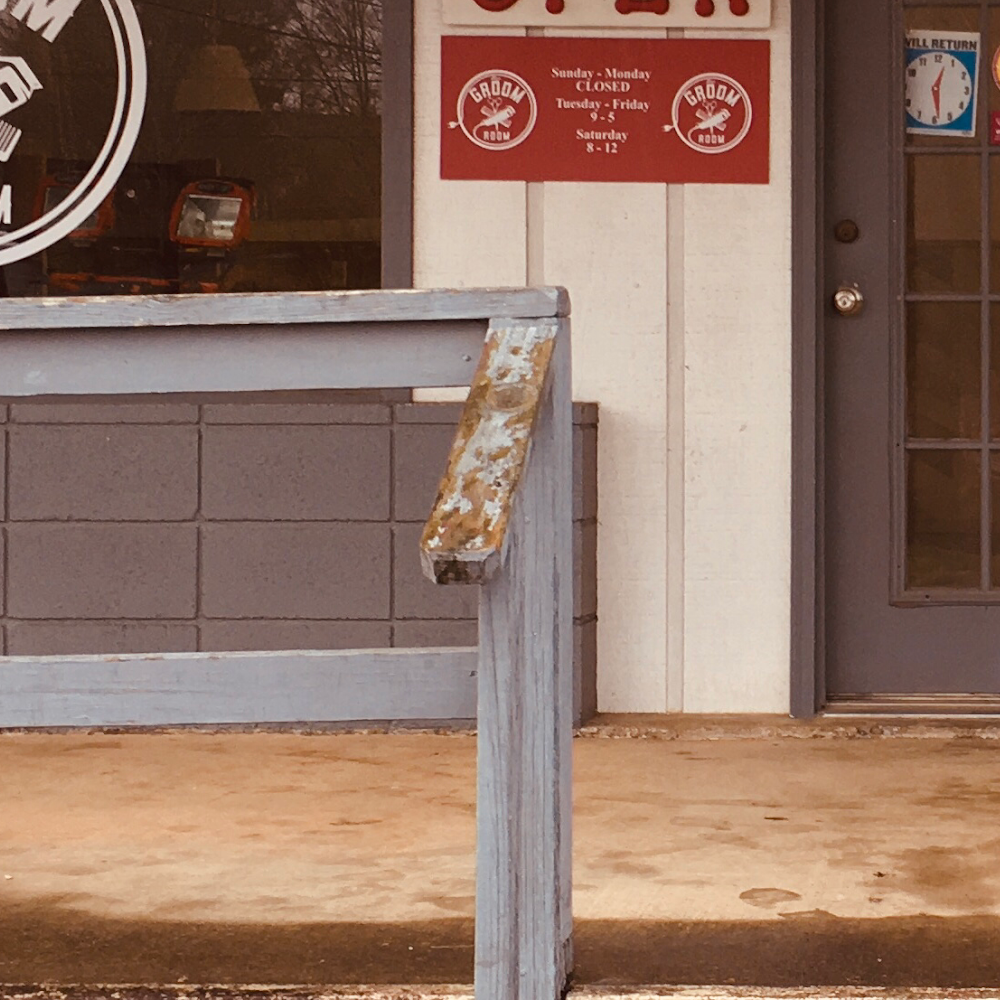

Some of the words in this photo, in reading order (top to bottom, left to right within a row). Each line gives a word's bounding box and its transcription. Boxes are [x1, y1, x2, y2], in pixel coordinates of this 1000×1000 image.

[931, 39, 977, 51] RETURN
[934, 54, 943, 63] 12
[551, 67, 594, 81] Sunday
[605, 67, 652, 82] Monday
[469, 80, 526, 104] GROOM
[576, 81, 631, 93] CLOSED
[684, 83, 741, 107] GROOM
[556, 98, 601, 112] Tuesday
[612, 98, 650, 113] Friday
[590, 112, 598, 122] 9
[607, 111, 615, 123] 5
[483, 131, 511, 141] ROOM
[576, 128, 629, 143] Saturday
[698, 134, 725, 144] ROOM
[586, 142, 594, 153] 8
[605, 142, 618, 153] 12
